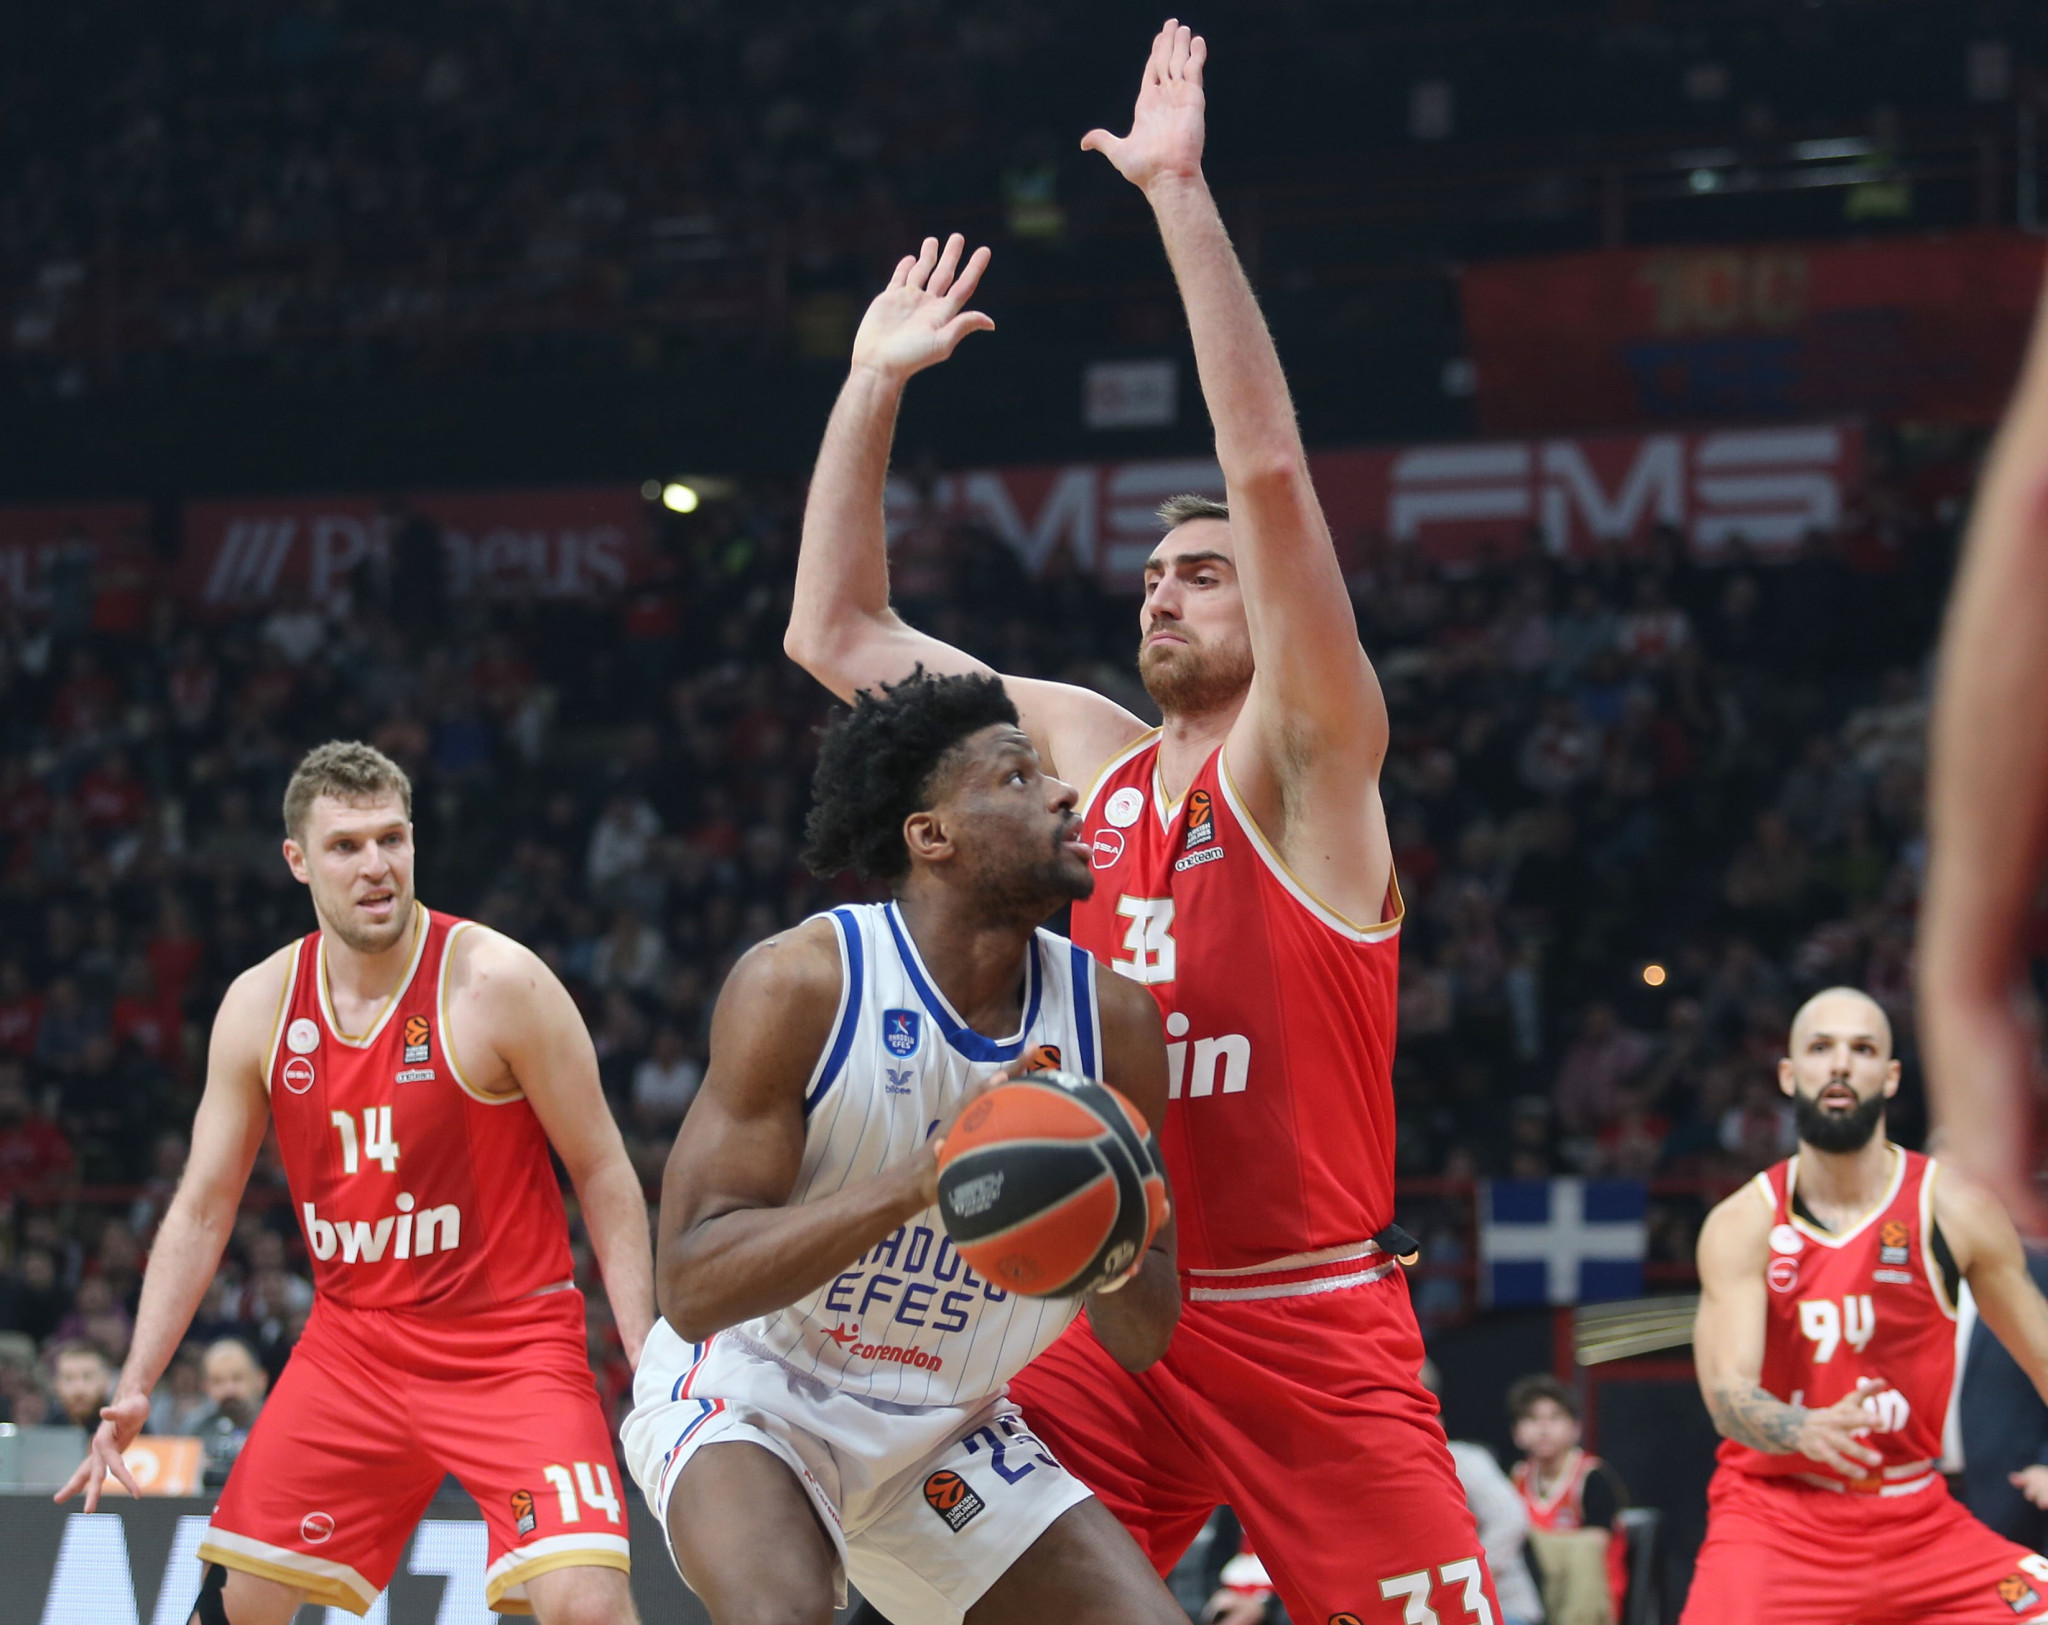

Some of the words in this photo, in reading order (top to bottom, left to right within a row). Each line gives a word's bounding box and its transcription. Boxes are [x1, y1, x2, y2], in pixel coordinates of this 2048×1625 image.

[1387, 426, 1843, 556] FMS
[1111, 894, 1176, 985] 33
[1166, 1012, 1251, 1100] in
[331, 1105, 400, 1174] 14
[303, 1192, 461, 1264] bwin
[825, 1271, 974, 1333] EFES
[1798, 1294, 1876, 1364] 94
[849, 1343, 943, 1372] corendon
[543, 1461, 622, 1525] 14
[946, 1493, 975, 1519] TURKISH
[950, 1498, 978, 1525] AIRLINES
[1378, 1556, 1495, 1625] 33
